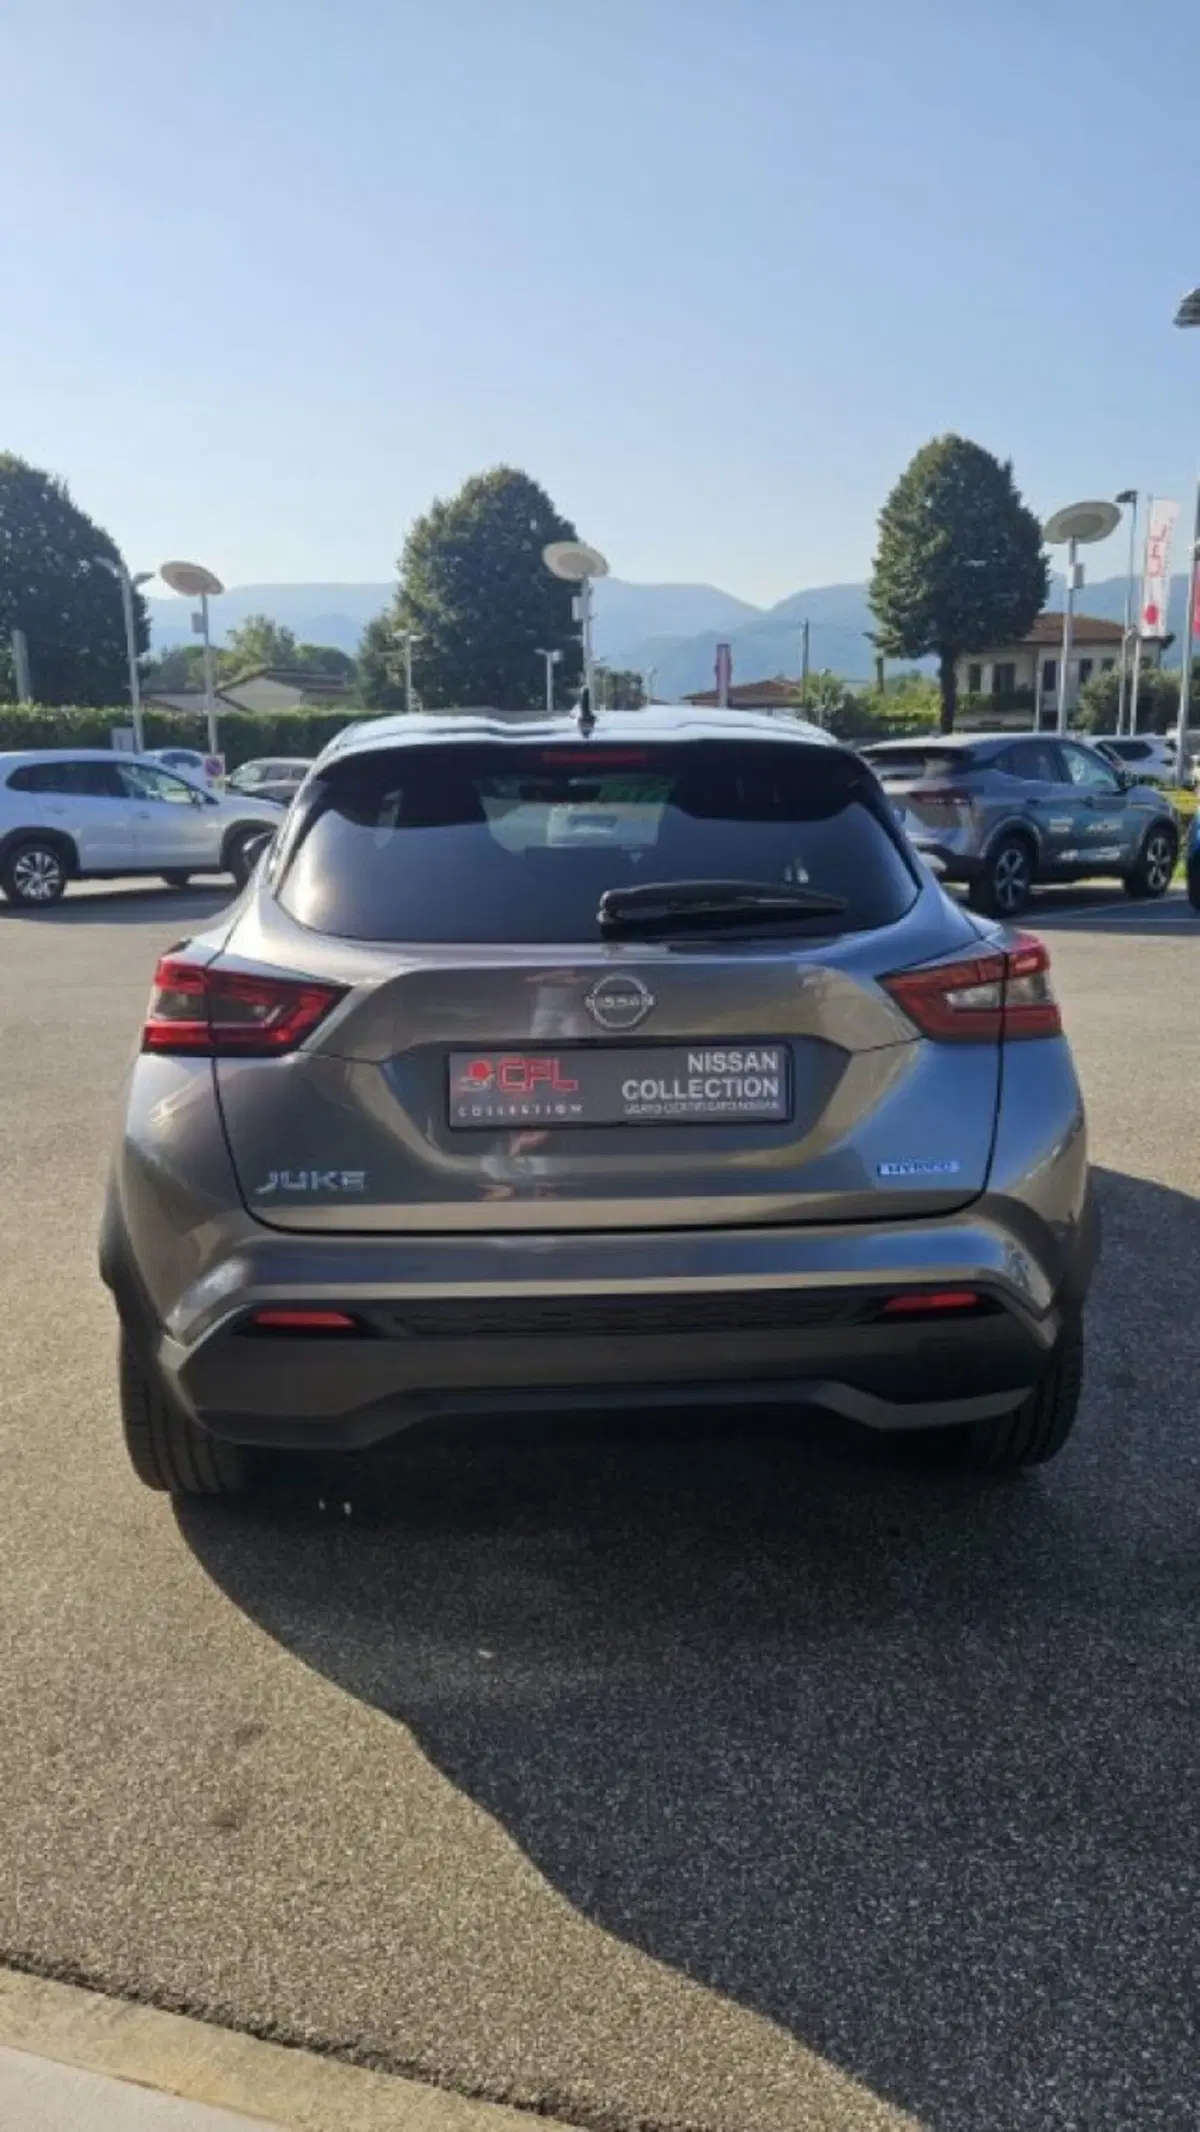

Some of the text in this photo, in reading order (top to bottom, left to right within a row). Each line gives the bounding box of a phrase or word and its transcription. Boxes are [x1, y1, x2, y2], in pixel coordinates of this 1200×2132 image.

[688, 1051, 779, 1073] NISSAN
[622, 1077, 779, 1101] COLLECTION
[255, 1170, 367, 1195] JUKE
